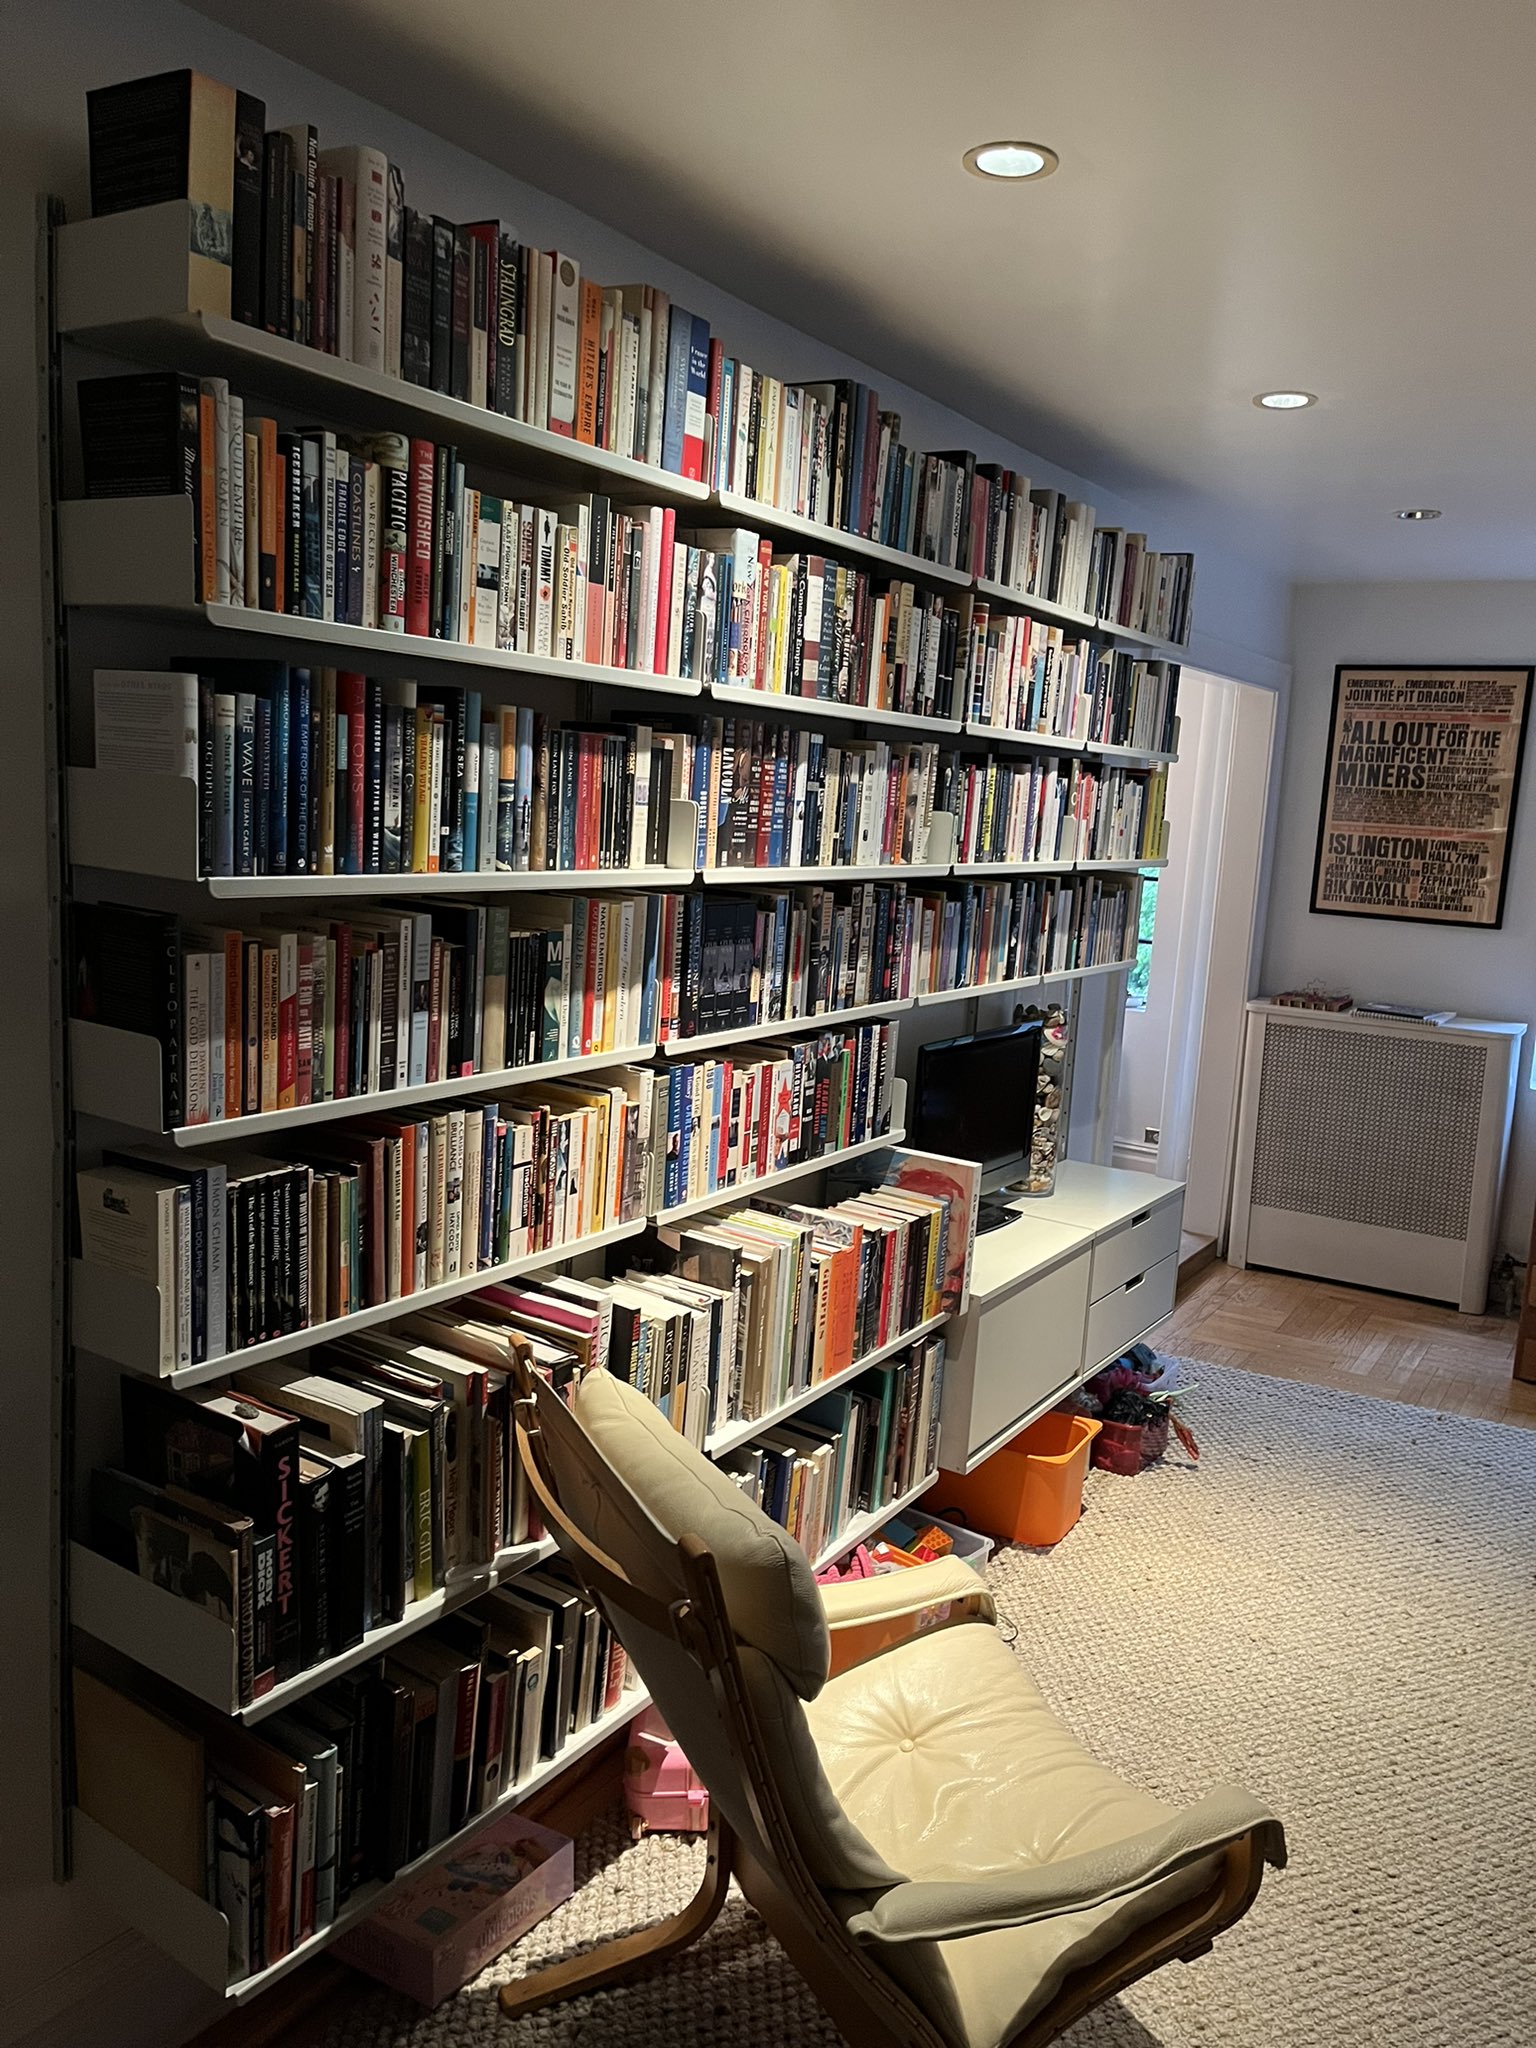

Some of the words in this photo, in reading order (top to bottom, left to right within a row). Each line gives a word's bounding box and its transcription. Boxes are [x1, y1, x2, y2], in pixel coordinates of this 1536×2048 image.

[307, 137, 318, 157] Not
[307, 159, 318, 190] Quite
[306, 191, 317, 232] Famous
[500, 259, 517, 347] STALINGRAD
[586, 339, 596, 389] HITLER'S
[583, 393, 592, 435] EMPIRE
[740, 371, 751, 418] PARIS
[230, 419, 243, 473] SQUID
[419, 450, 433, 460] THE
[219, 465, 229, 528] KRAKEN
[291, 446, 301, 529] ICEBREAKER
[337, 482, 348, 528] FRAGILE
[390, 469, 408, 532] PACIFIC
[205, 496, 213, 536] GIANT
[232, 475, 244, 546] EMPIRE
[326, 496, 334, 532] EXTREME
[351, 472, 362, 562] COASTLINES
[416, 462, 434, 560] VANQUISHED
[953, 504, 961, 537] SNOW
[326, 533, 334, 553] LIFE
[337, 530, 346, 554] EDGE
[368, 501, 376, 569] WRECKERS
[522, 520, 533, 567] SOMME
[325, 566, 333, 582] THE
[326, 554, 333, 564] OF
[540, 545, 552, 584] TOMMY
[562, 547, 570, 597] Old-Soldier
[762, 568, 770, 586] NEW
[325, 583, 333, 599] SEA
[389, 553, 399, 613] WINCHESTER
[761, 590, 769, 614] YORK
[797, 579, 808, 637] Comanche
[742, 608, 750, 676] CHRONOLOGY
[793, 638, 804, 677] Empire
[374, 686, 382, 709] NICK
[1345, 690, 1372, 701] JOIN
[1374, 690, 1395, 702] THE
[1397, 690, 1415, 703] PIT
[1417, 691, 1466, 704] DRAGON
[242, 704, 254, 734] THE
[352, 680, 364, 794] FATHOMS
[1351, 721, 1389, 746] ALL
[1392, 721, 1438, 747] OUT
[1437, 730, 1469, 748] FOR
[1470, 731, 1502, 749] THE
[224, 734, 232, 771] Shark
[241, 740, 254, 786] WAVE
[300, 724, 308, 774] EMPERORS
[456, 755, 464, 778] SEA
[1338, 745, 1448, 766] MAGNIFICENT
[204, 740, 214, 815] OCTOPUS!
[223, 774, 232, 814] Drunk
[372, 779, 380, 812] SPYING
[392, 751, 400, 809] LEVIATHAN
[419, 773, 427, 805] VOYAGE
[720, 747, 735, 804] LINCOLN
[1335, 762, 1427, 790] MINERS
[372, 815, 380, 828] ON
[699, 790, 708, 829] DOUGLASS
[371, 832, 380, 867] WHALES
[1328, 833, 1428, 861] ISLINGTON
[1429, 839, 1459, 852] TOWN
[1350, 856, 1372, 866] FRANK
[1375, 858, 1411, 869] CHICKENS
[1428, 851, 1452, 863] HALL
[1455, 852, 1480, 865] 7PM
[1323, 879, 1348, 894] RIK
[1350, 880, 1409, 900] MAYALL
[1419, 876, 1480, 890] ZEPHANIAH
[1421, 862, 1488, 879] BENJAMIN
[575, 901, 586, 970] OUTSIDER
[590, 906, 598, 957] OUTSIDER
[599, 906, 607, 940] NAKED
[230, 939, 238, 977] Richard
[271, 954, 279, 975] HOW
[299, 963, 313, 985] THE
[596, 942, 605, 993] EMPERORS
[674, 945, 683, 990] FOUNDING
[190, 988, 199, 1014] THE
[229, 980, 237, 1024] Dawkins
[263, 954, 271, 1009] CONQUERED
[299, 986, 313, 1006] END
[166, 944, 179, 1102] CLEOPATRA
[270, 977, 278, 1041] MUMBO-JUMBO
[190, 1016, 199, 1046] GOD
[298, 1020, 312, 1050] FAITH
[199, 1050, 207, 1095] DAWKINS
[862, 1036, 872, 1073] MONEY
[189, 1050, 199, 1113] DELUSION
[674, 1068, 683, 1129] REPORTER
[792, 1061, 801, 1117] NIXONLAND
[450, 1122, 458, 1173] BRILLIANCE
[682, 1132, 691, 1187] BERNSTEIN
[195, 1177, 204, 1219] WHALES
[211, 1176, 221, 1217] SIMON
[523, 1168, 531, 1218] modernism
[211, 1220, 221, 1273] SCHAMA
[272, 1226, 280, 1261] painting
[448, 1212, 456, 1254] HAYCOCK
[195, 1230, 205, 1279] DOLPHINS
[935, 1228, 949, 1285] Kooning
[819, 1268, 830, 1341] GROPIUS
[662, 1329, 675, 1386] PICASSO
[690, 1335, 702, 1392] PICASSO
[909, 1364, 922, 1423] TITIAN
[417, 1488, 432, 1529] ERIC
[276, 1455, 294, 1616] SICKERT
[418, 1531, 432, 1570] GILL
[257, 1551, 266, 1611] DICK
[265, 1548, 274, 1605] MOBY
[240, 1575, 253, 1641] HAROLD
[240, 1644, 254, 1698] OWEN
